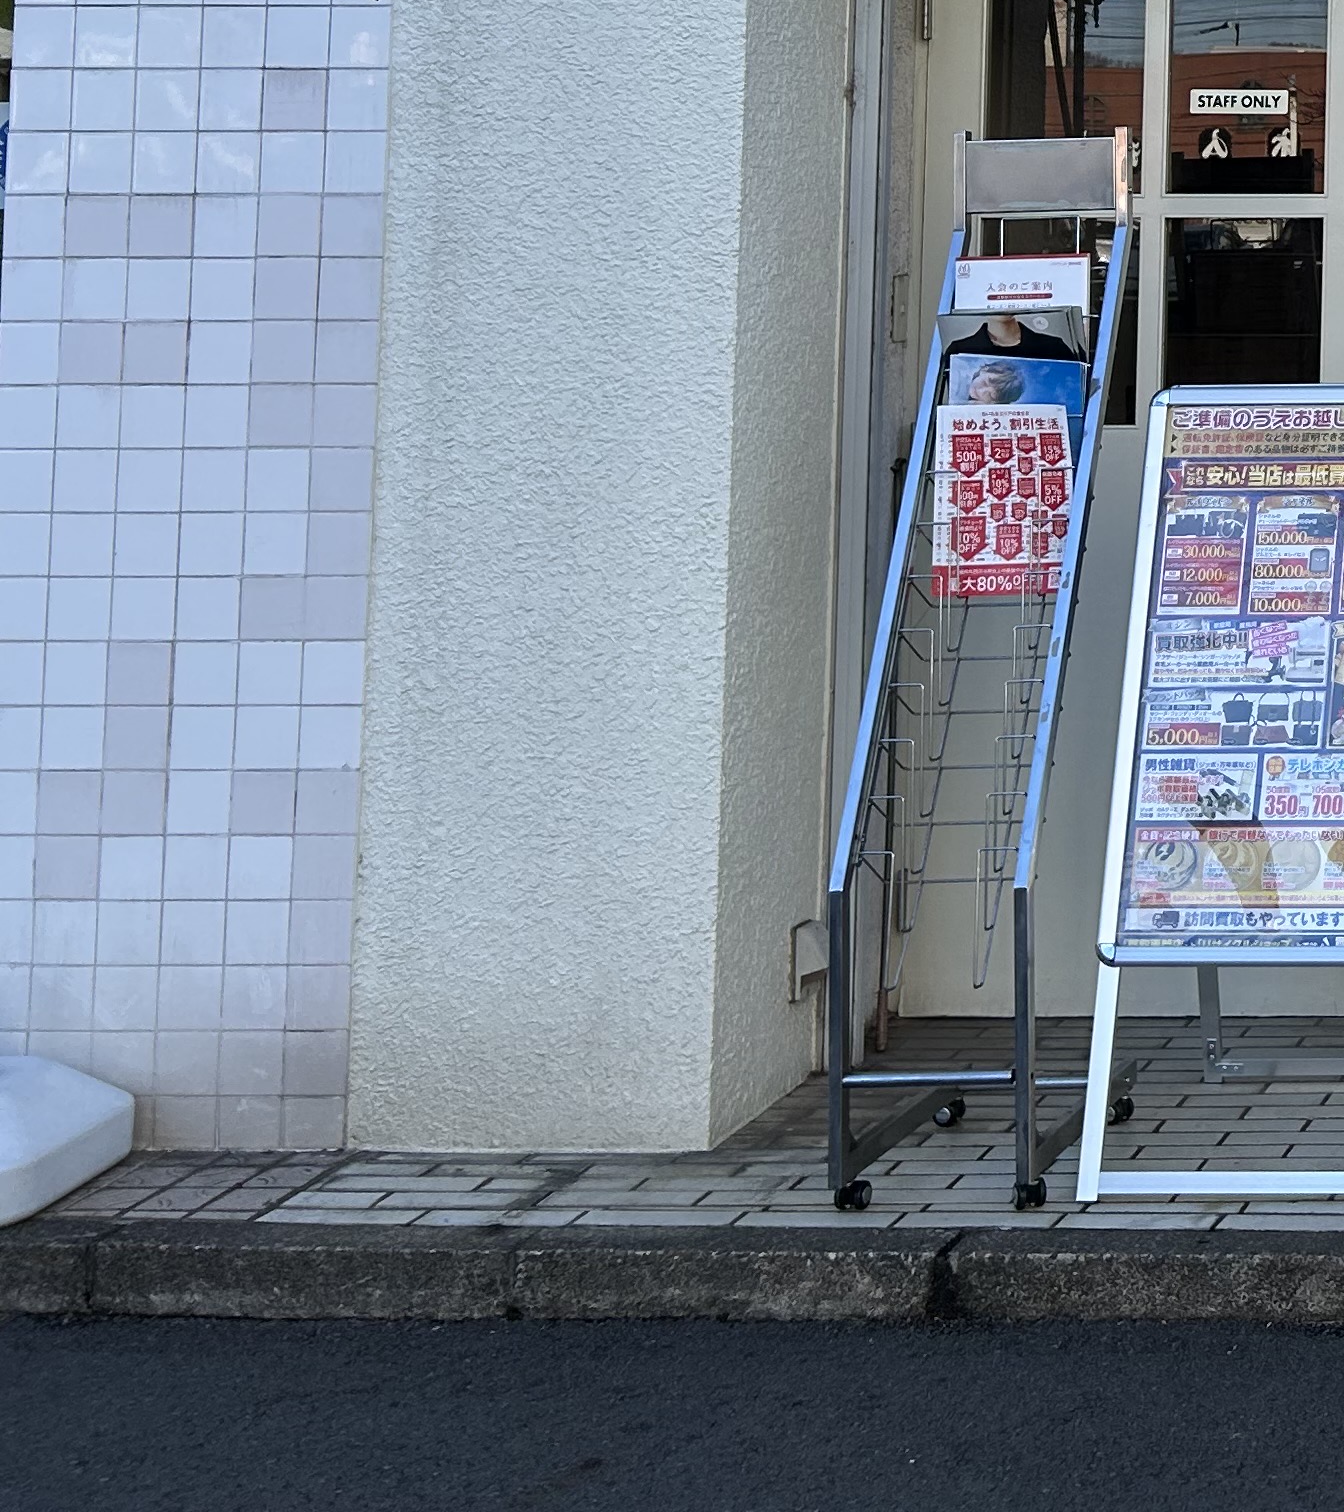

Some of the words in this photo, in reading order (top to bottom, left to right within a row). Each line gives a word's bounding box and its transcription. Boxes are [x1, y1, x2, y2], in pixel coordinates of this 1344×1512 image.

[1197, 95, 1238, 110] STAFF
[1240, 95, 1282, 110] ONLY
[985, 280, 1054, 293] 入会のご案内
